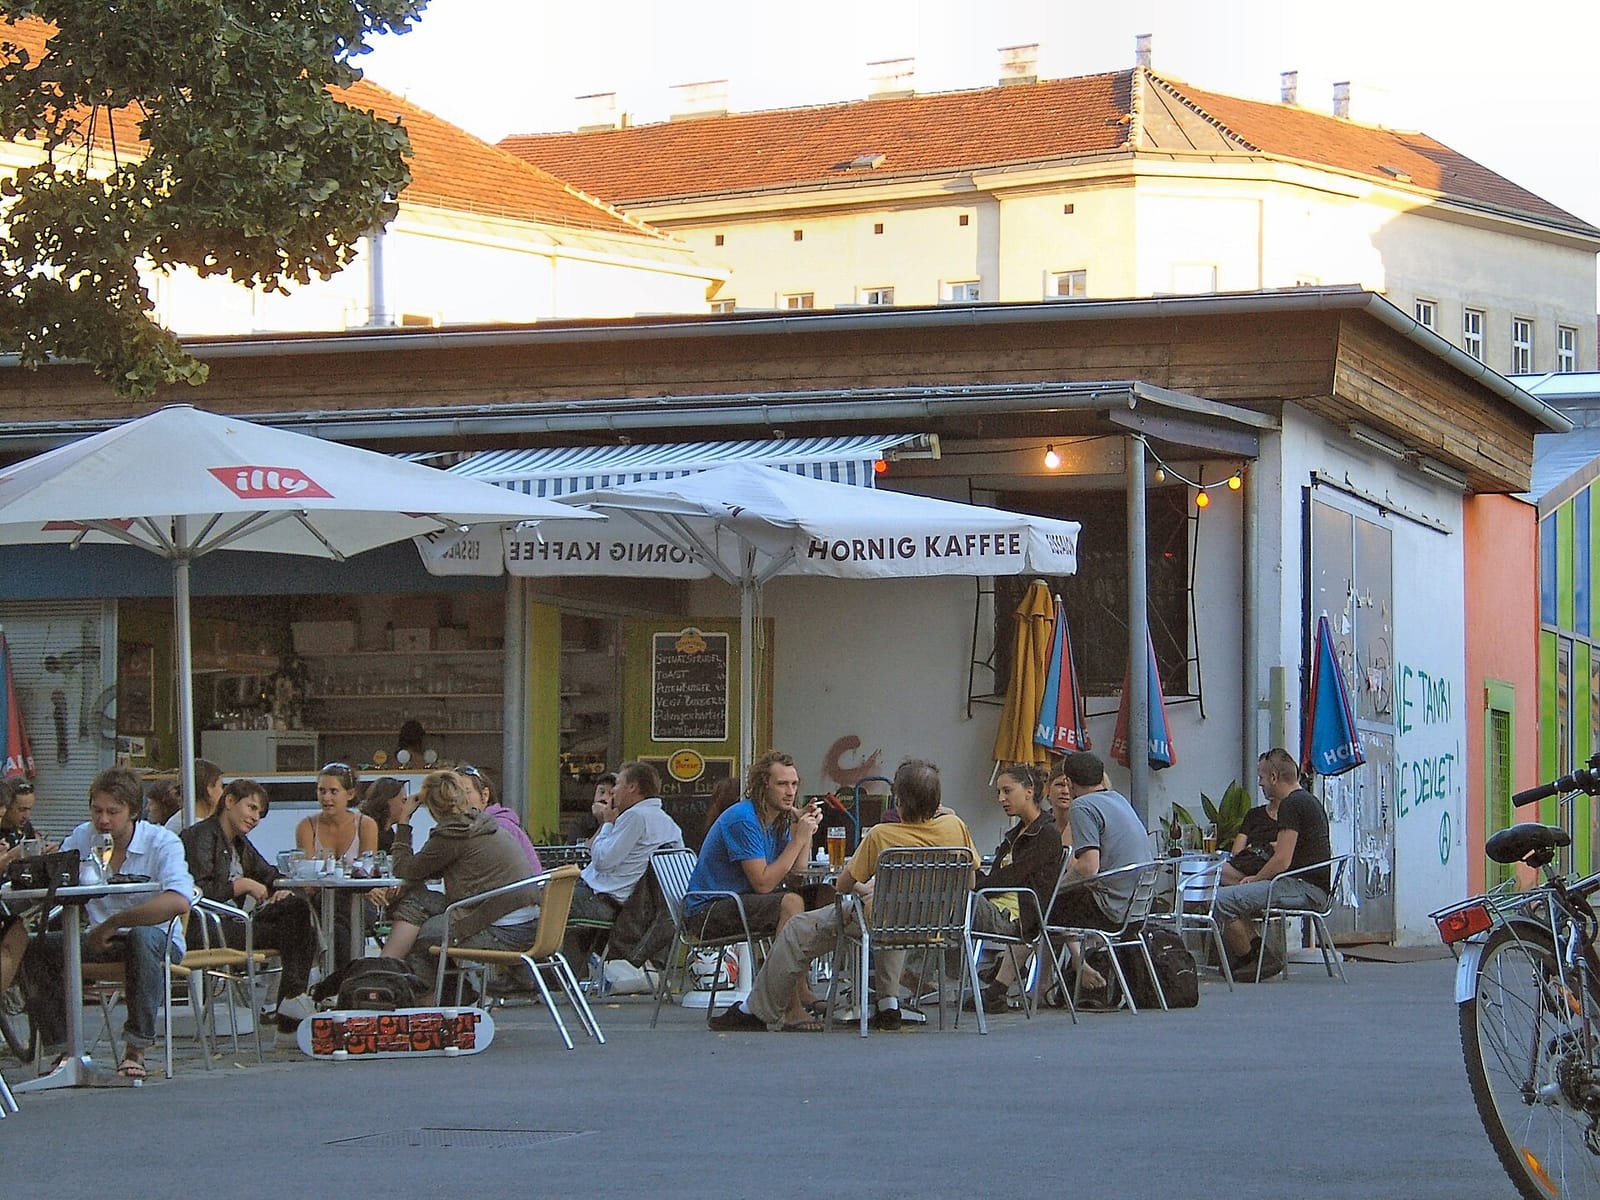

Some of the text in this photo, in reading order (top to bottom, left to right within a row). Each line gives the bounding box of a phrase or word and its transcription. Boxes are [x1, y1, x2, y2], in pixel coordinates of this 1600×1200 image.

[236, 469, 309, 495] illy
[807, 533, 1021, 562] HORNIG KAFFEE
